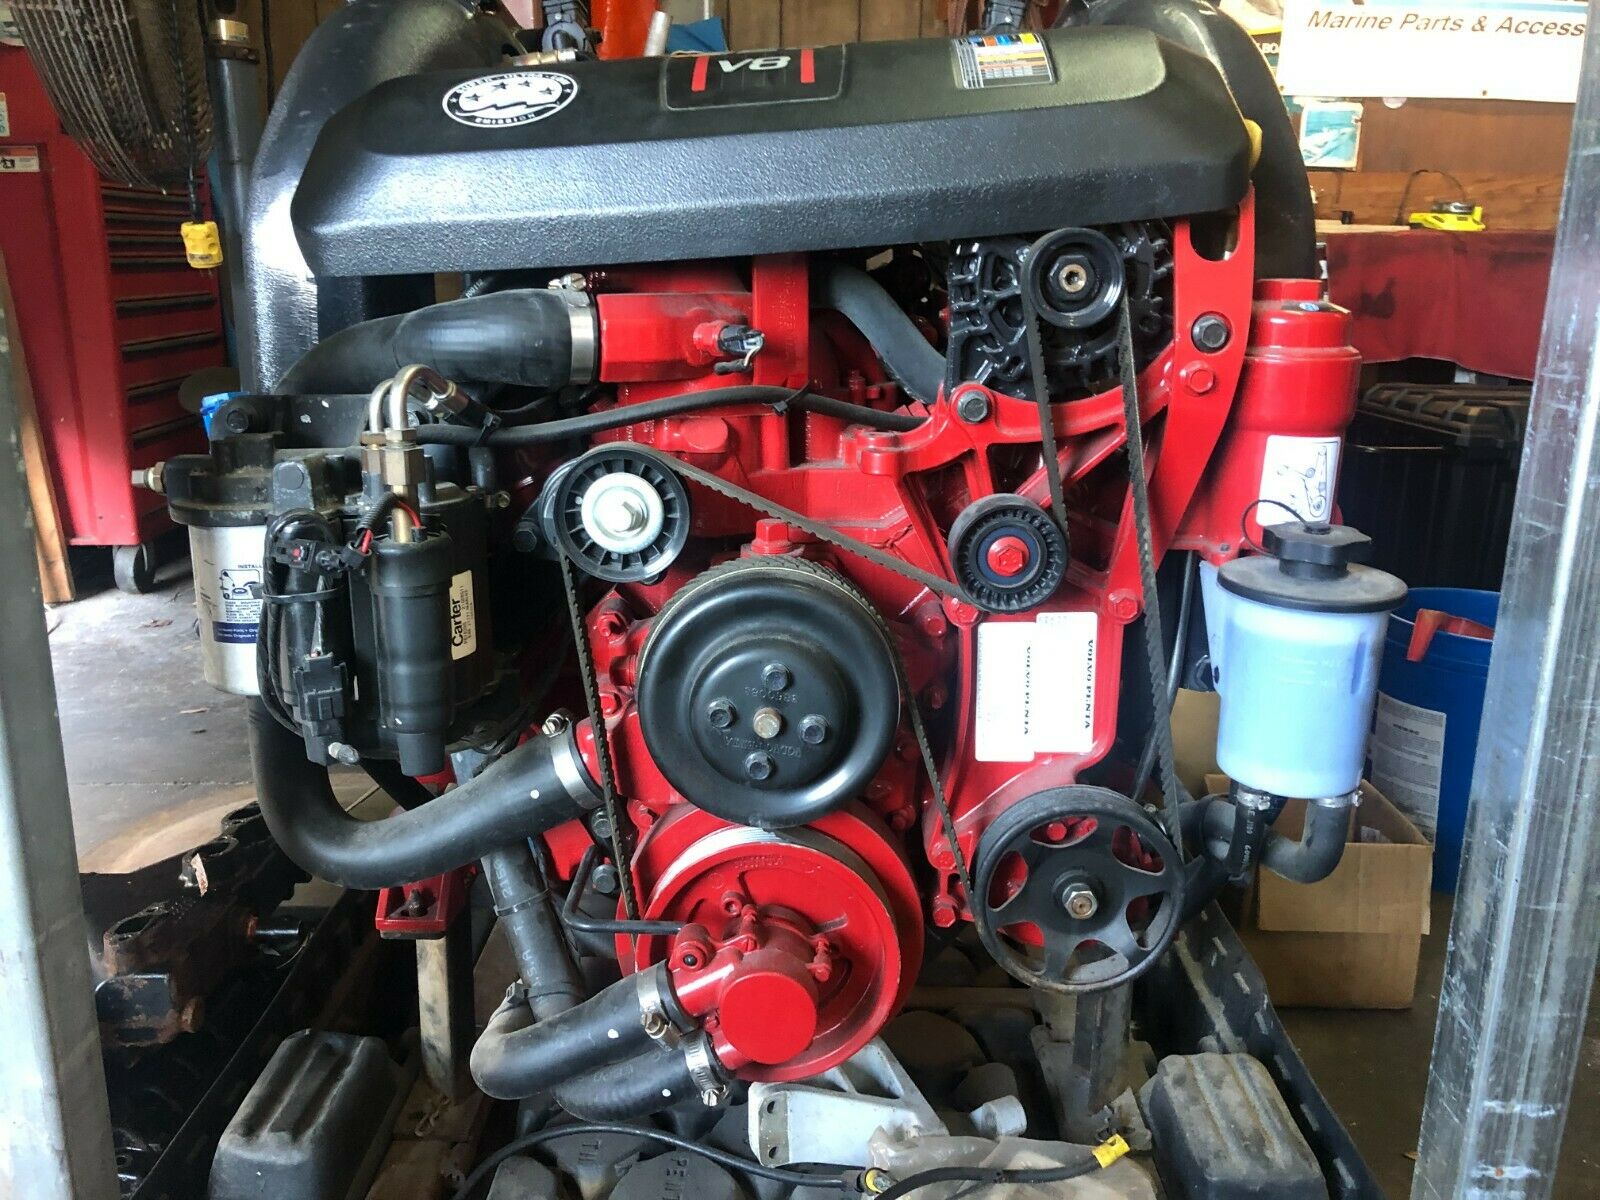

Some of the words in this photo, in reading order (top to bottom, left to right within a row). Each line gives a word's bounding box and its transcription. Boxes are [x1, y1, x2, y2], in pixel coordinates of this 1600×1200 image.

[1307, 10, 1393, 30] Marine
[1400, 13, 1464, 31] Parts
[1471, 15, 1487, 32] &
[718, 55, 791, 73] V8
[451, 598, 463, 647] Carter
[1086, 639, 1094, 682] VOLVO
[1084, 685, 1092, 729] PENTA
